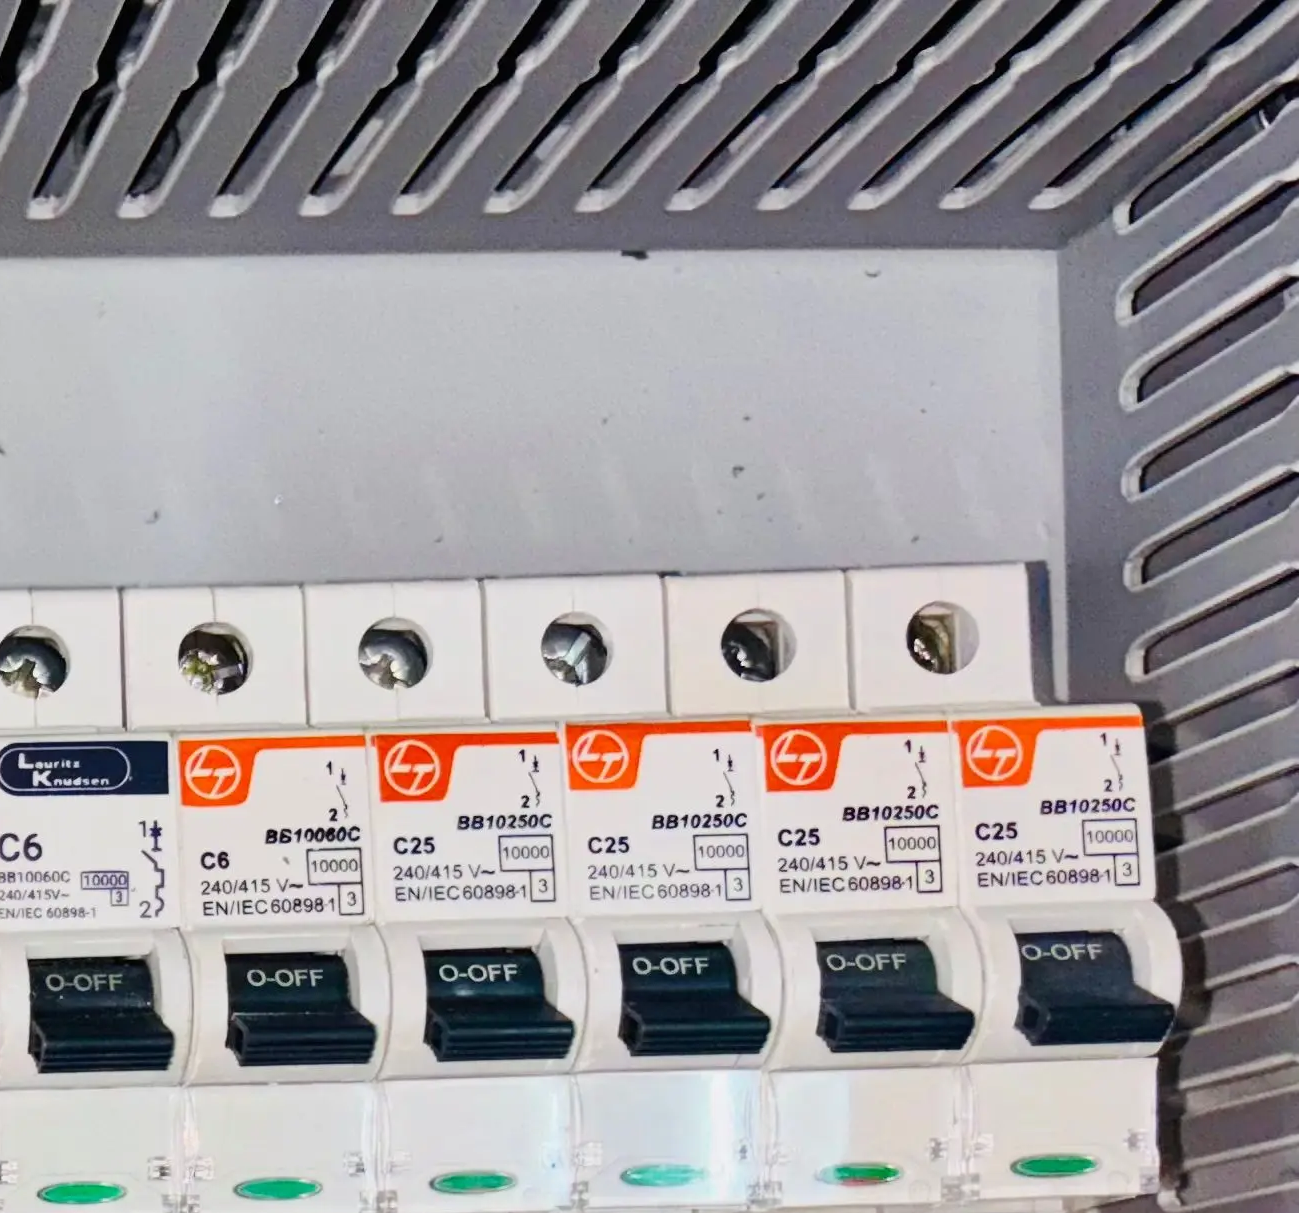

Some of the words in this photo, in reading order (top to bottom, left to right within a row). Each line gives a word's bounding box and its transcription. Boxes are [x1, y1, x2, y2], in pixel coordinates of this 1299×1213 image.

[843, 806, 939, 821] BB10250C
[1040, 799, 1135, 815] BB10250C
[457, 814, 552, 830] BB10250C
[652, 814, 747, 829] BB10250C
[778, 829, 820, 845] C25
[975, 823, 1017, 839] C25
[1087, 830, 1133, 843] 10000
[393, 838, 435, 854] C25
[588, 837, 630, 853] C25
[889, 837, 936, 850] 10000
[504, 847, 550, 858] 10000
[698, 845, 745, 858] 10000
[975, 851, 1046, 866] 240/415
[200, 852, 230, 869] C6
[311, 860, 358, 872] 10000
[778, 858, 847, 872] 240/415
[393, 865, 462, 879] 240/415
[588, 865, 657, 879] 240/415
[925, 871, 934, 883] 3
[1122, 864, 1132, 877] 3
[85, 875, 126, 886] 10000
[734, 878, 743, 891] 3
[780, 878, 845, 893] EN/IEC
[848, 876, 912, 891] 60898-1
[978, 872, 1043, 887] EN/IEC
[1046, 870, 1111, 884] 60898-1
[201, 879, 270, 895] 240/415
[395, 886, 459, 900] EN/IEC
[463, 885, 526, 899] 60898-1
[539, 880, 547, 893] 3
[590, 886, 654, 899] EN/IEC
[658, 884, 721, 898] 60898-1
[203, 901, 268, 916] EN/IEC
[271, 898, 335, 914] 60898-1
[347, 893, 357, 906] 3
[1022, 944, 1101, 961] O-OFF
[632, 958, 709, 975] O-OFF
[826, 954, 906, 971] O-OFF
[247, 969, 323, 987] O-OFF
[439, 964, 518, 982] O-OFF
[46, 974, 122, 991] O-OFF
